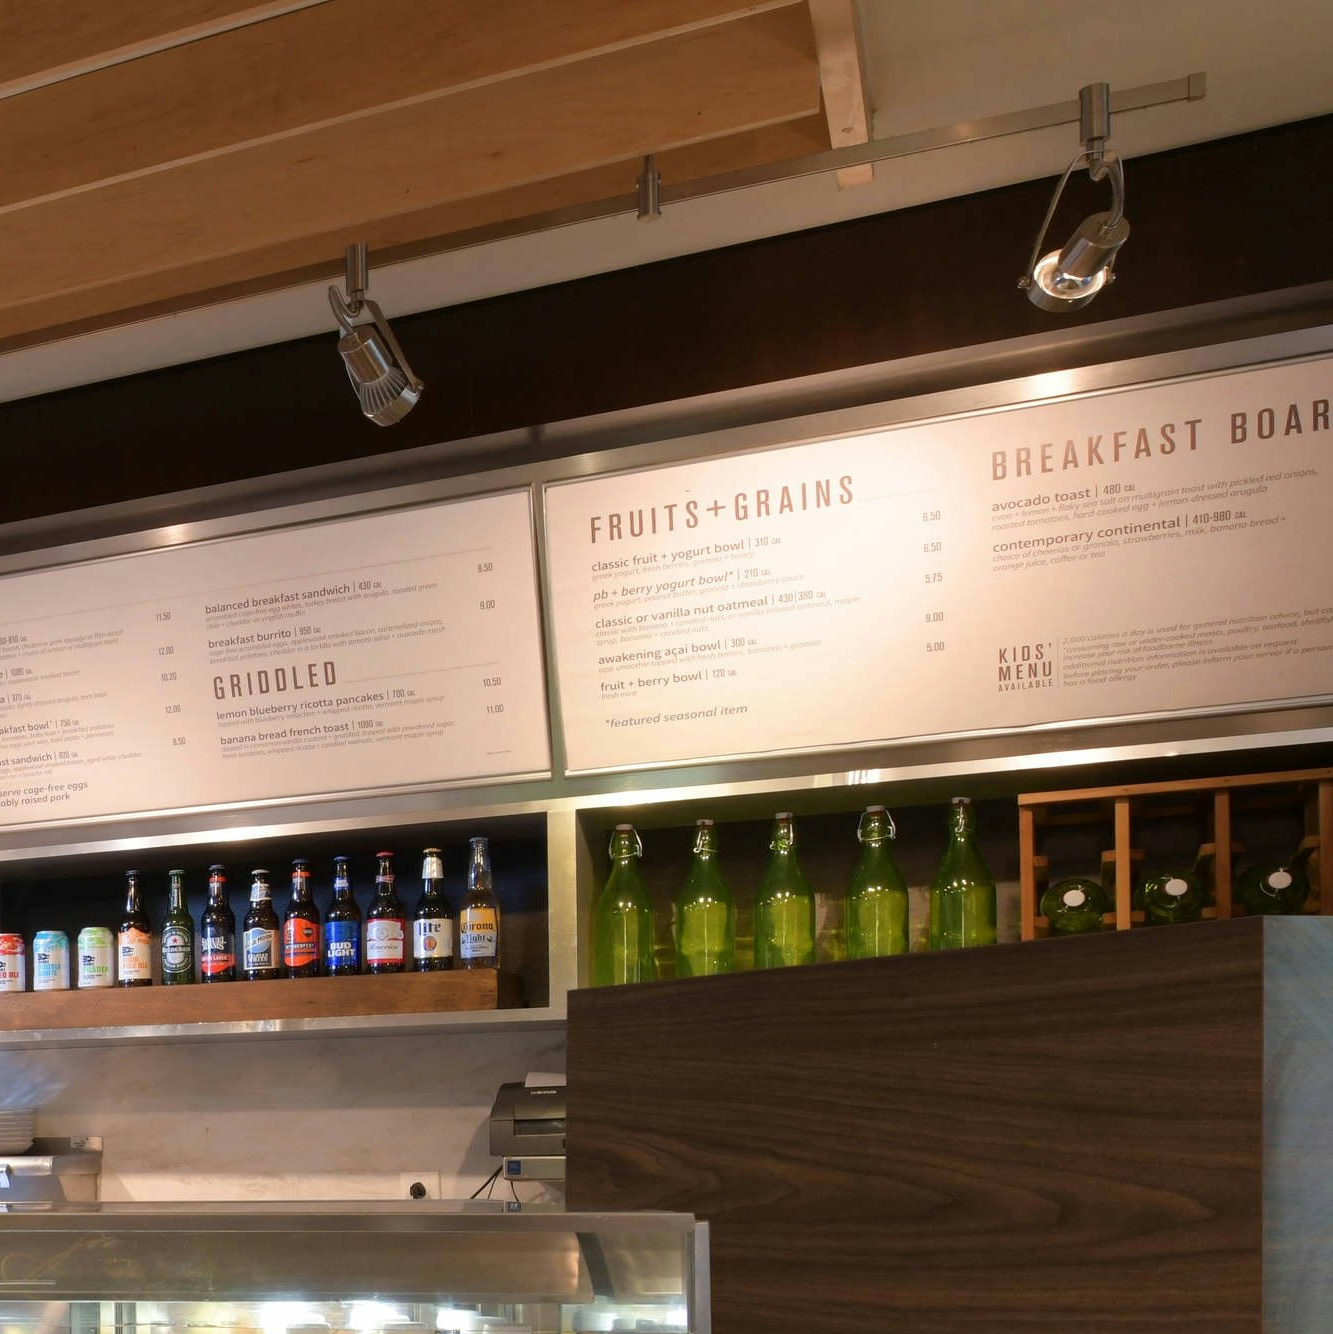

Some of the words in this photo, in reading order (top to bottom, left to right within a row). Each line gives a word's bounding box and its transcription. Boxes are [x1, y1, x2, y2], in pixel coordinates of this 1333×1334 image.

[991, 418, 1203, 481] BREAKFAST
[1230, 399, 1331, 444] BOAR
[991, 494, 1051, 512] avocado
[1054, 488, 1091, 503] toast
[1102, 483, 1121, 495] 480
[992, 530, 1094, 553] contemporary
[1096, 517, 1181, 539] continental
[1192, 510, 1232, 526] 410-980
[591, 557, 630, 572] classic
[632, 552, 658, 566] fruit
[670, 545, 712, 563] yogurt
[714, 539, 745, 554] bowl
[205, 598, 250, 615] balanced
[252, 592, 300, 608] breakfast
[301, 584, 351, 600] sandwich
[593, 588, 609, 602] pb
[621, 579, 653, 598] berry
[655, 576, 696, 594] yogurt
[595, 614, 634, 629] classic
[635, 613, 650, 624] or
[651, 606, 691, 623] vanilla
[693, 603, 715, 616] nut
[717, 595, 769, 613] oatmeal
[208, 634, 255, 649] breakfast
[257, 628, 292, 643] burrito
[598, 648, 662, 666] awakening
[691, 640, 722, 654] bowl
[213, 661, 337, 700] GRIDDLED
[600, 680, 625, 692] fruit
[637, 674, 670, 690] berry
[672, 669, 703, 684] bowl
[998, 661, 1052, 682] MENU
[998, 679, 1054, 692] AVAILABLE
[216, 708, 247, 721] lemon
[249, 701, 298, 718] blueberry
[299, 697, 334, 711] ricotta
[335, 691, 384, 708] pancakes
[663, 707, 718, 723] seasonal
[719, 703, 749, 718] item
[220, 734, 257, 746] banana
[258, 728, 287, 742] bread
[289, 724, 322, 739] french
[323, 721, 349, 734] toast
[11, 752, 53, 767] sandwich
[21, 794, 48, 806] raised
[50, 791, 71, 804] pork
[23, 783, 66, 797] cage-free
[67, 781, 89, 793] eggs
[327, 949, 356, 958] LIGHT
[330, 942, 352, 950] BUD
